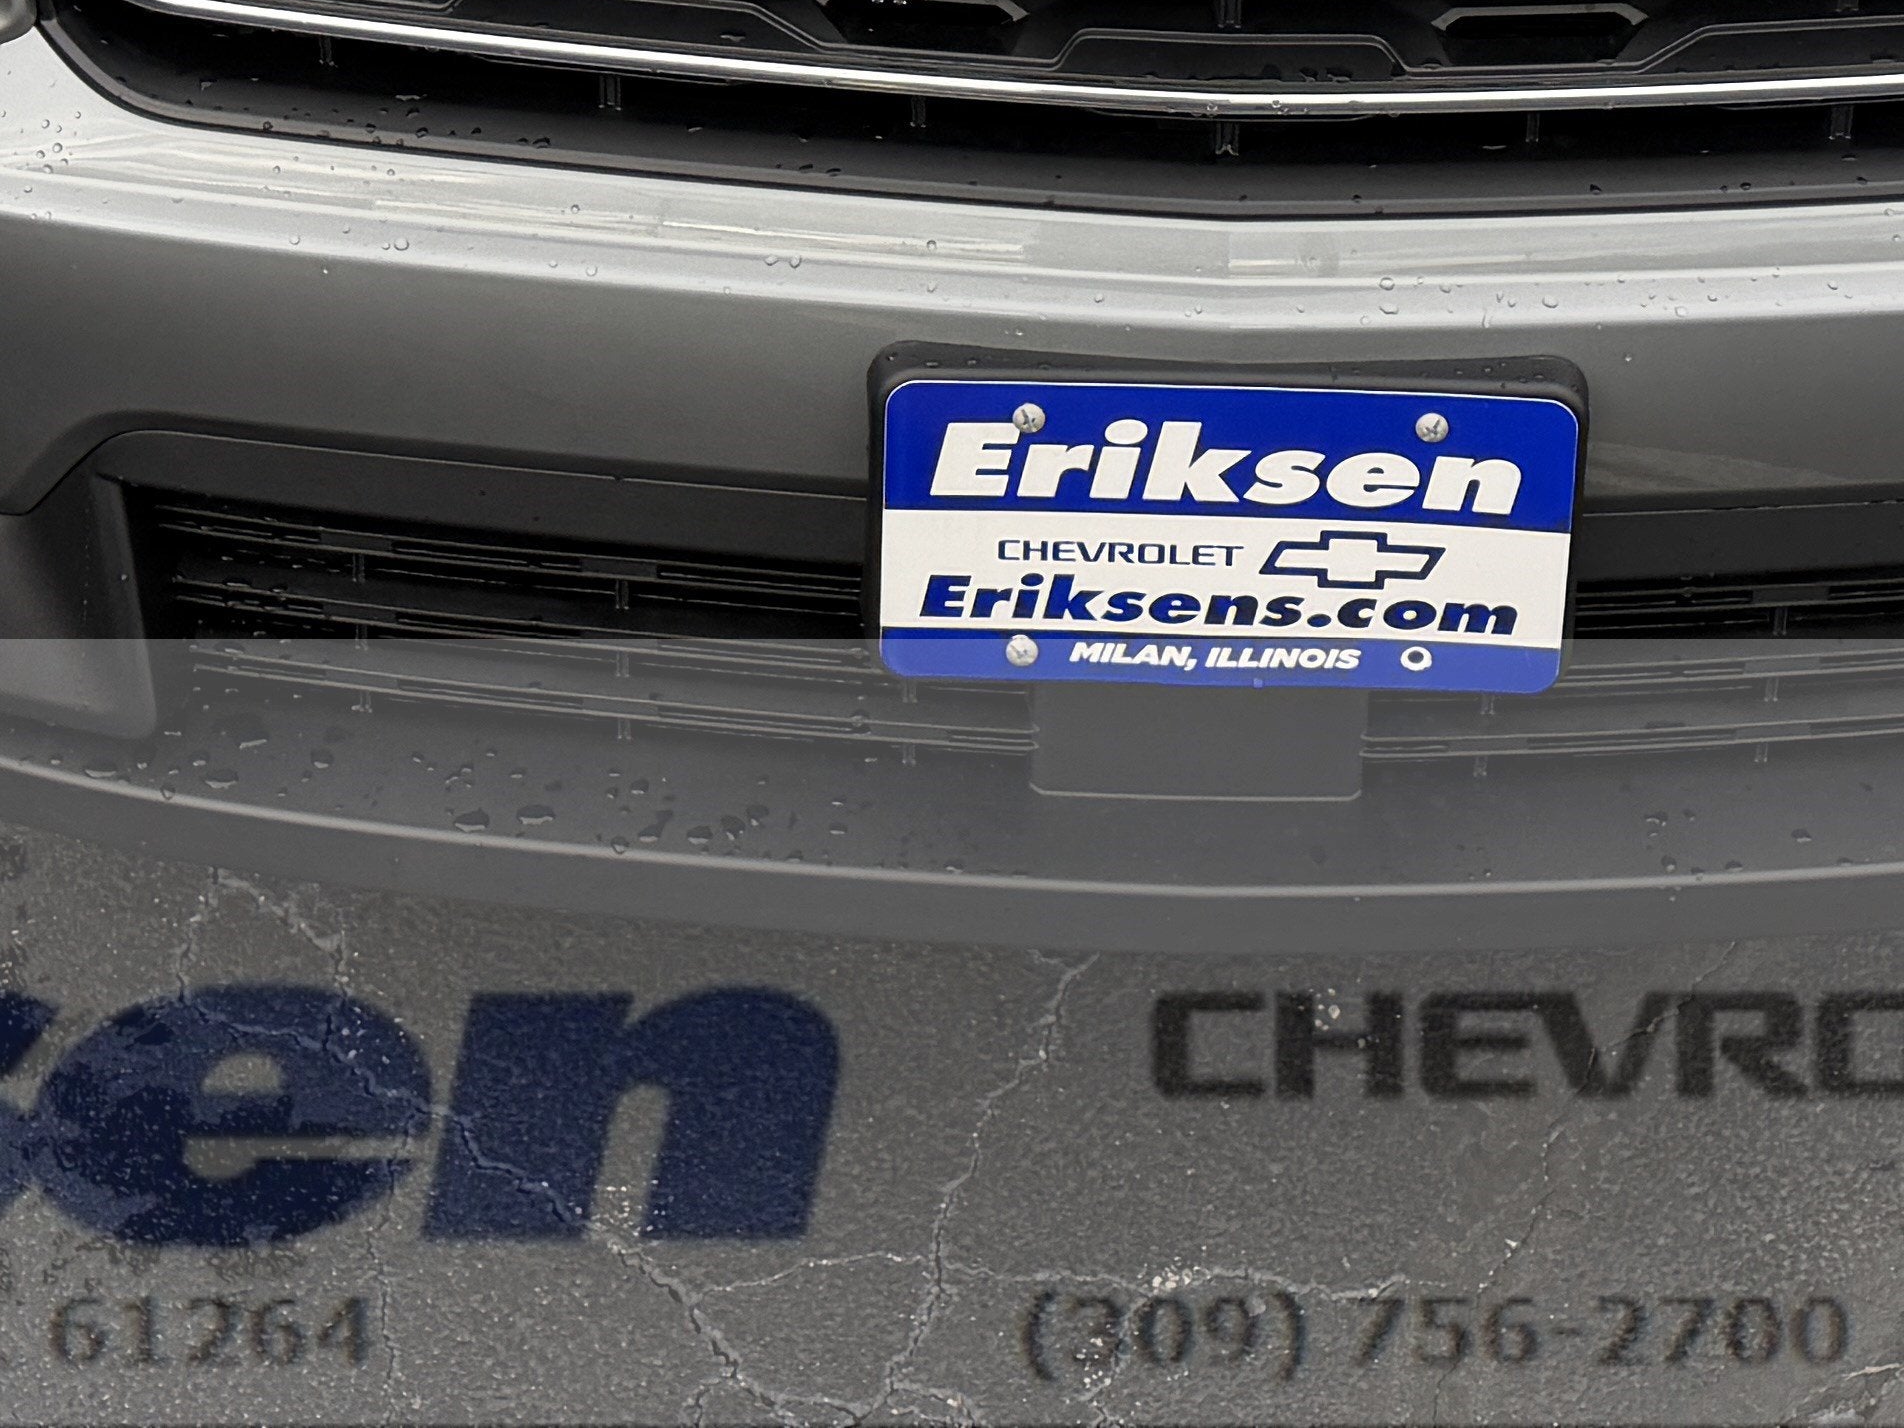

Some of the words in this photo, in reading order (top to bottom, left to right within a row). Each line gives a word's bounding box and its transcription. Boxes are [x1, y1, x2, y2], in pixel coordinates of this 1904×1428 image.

[929, 419, 1522, 517] Eriksen
[997, 537, 1244, 568] CHEVROLET
[918, 573, 1518, 636] Eriksens.com
[1068, 640, 1197, 670] MILAN,
[1204, 646, 1361, 671] ILLINOIS
